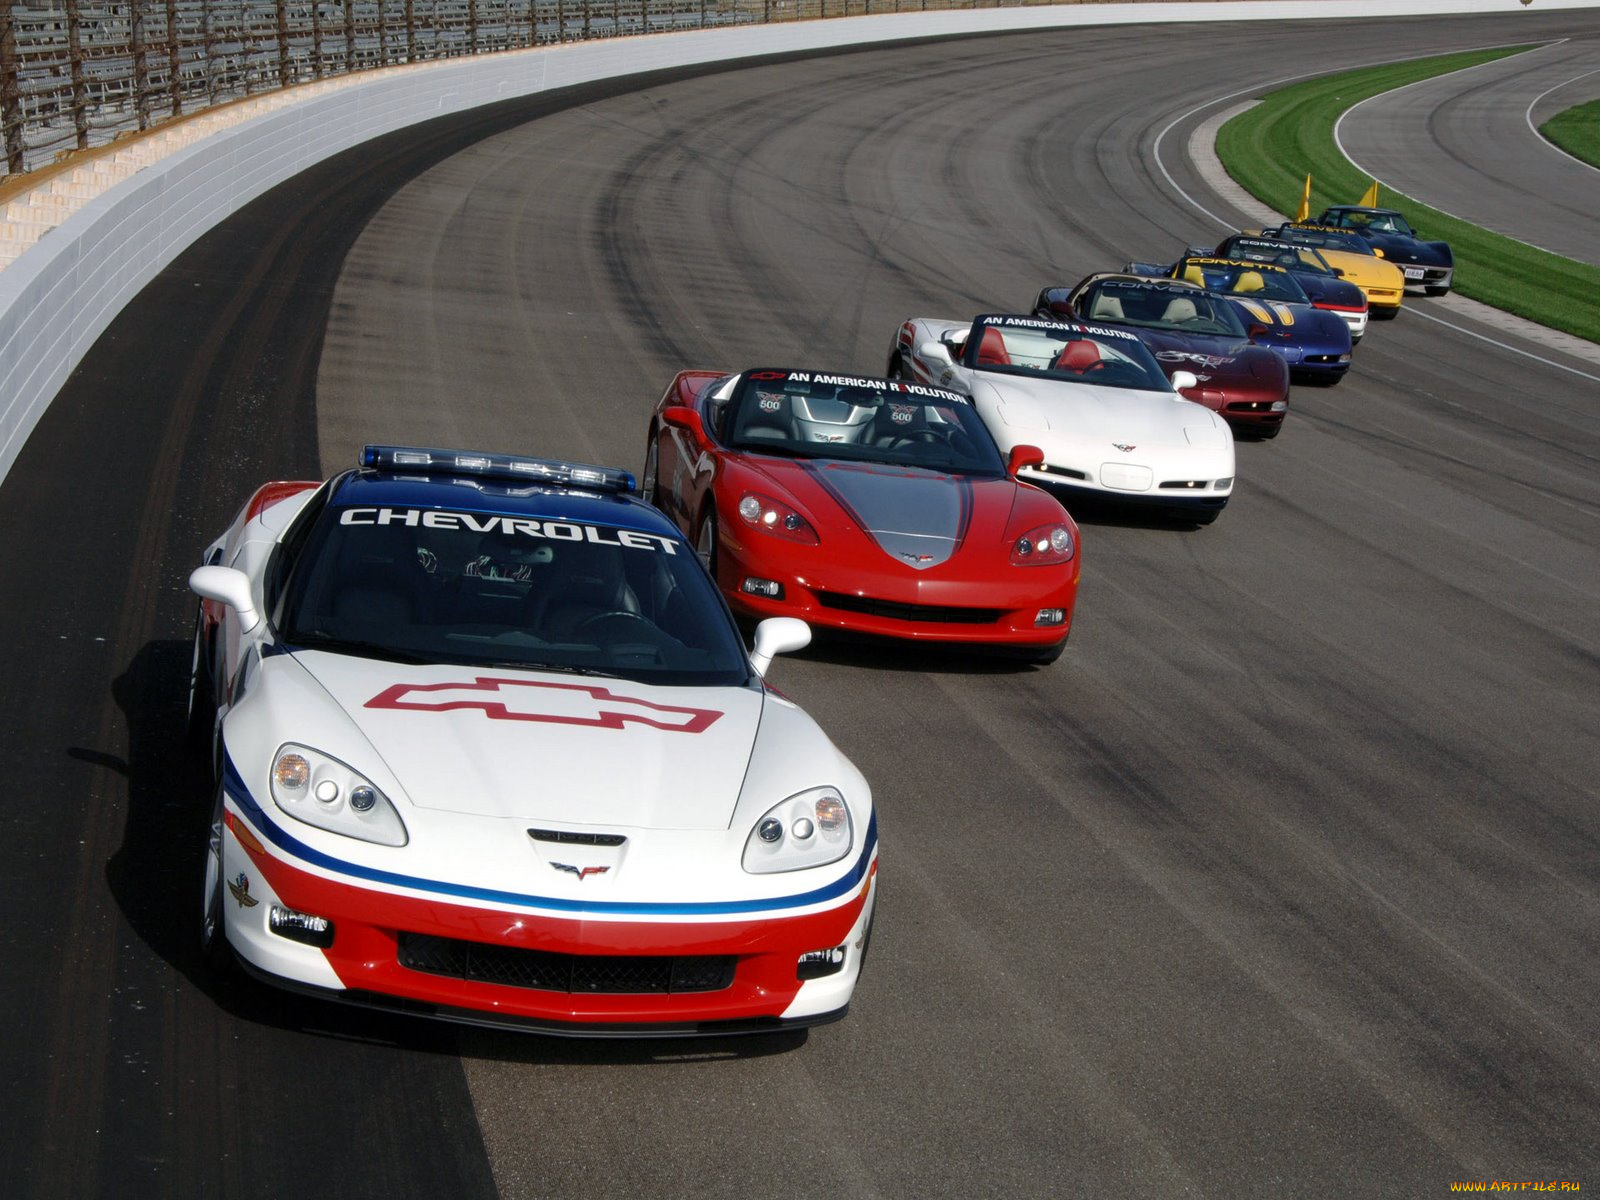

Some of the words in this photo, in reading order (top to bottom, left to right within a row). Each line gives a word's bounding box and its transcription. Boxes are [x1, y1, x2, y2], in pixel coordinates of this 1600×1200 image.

[1289, 223, 1356, 235] CORVETTE
[1239, 239, 1313, 252] CORVETTE
[1186, 257, 1288, 273] CORVETTE
[1101, 281, 1224, 299] CORVETTE
[983, 316, 1003, 325] AN
[1005, 318, 1071, 332] AMERICAN
[788, 372, 811, 382] AN
[814, 374, 886, 390] AMERICAN
[889, 382, 968, 405] REVOLUTION
[759, 400, 781, 411] 500
[892, 412, 912, 423] 500
[339, 508, 680, 556] CHEVROLET
